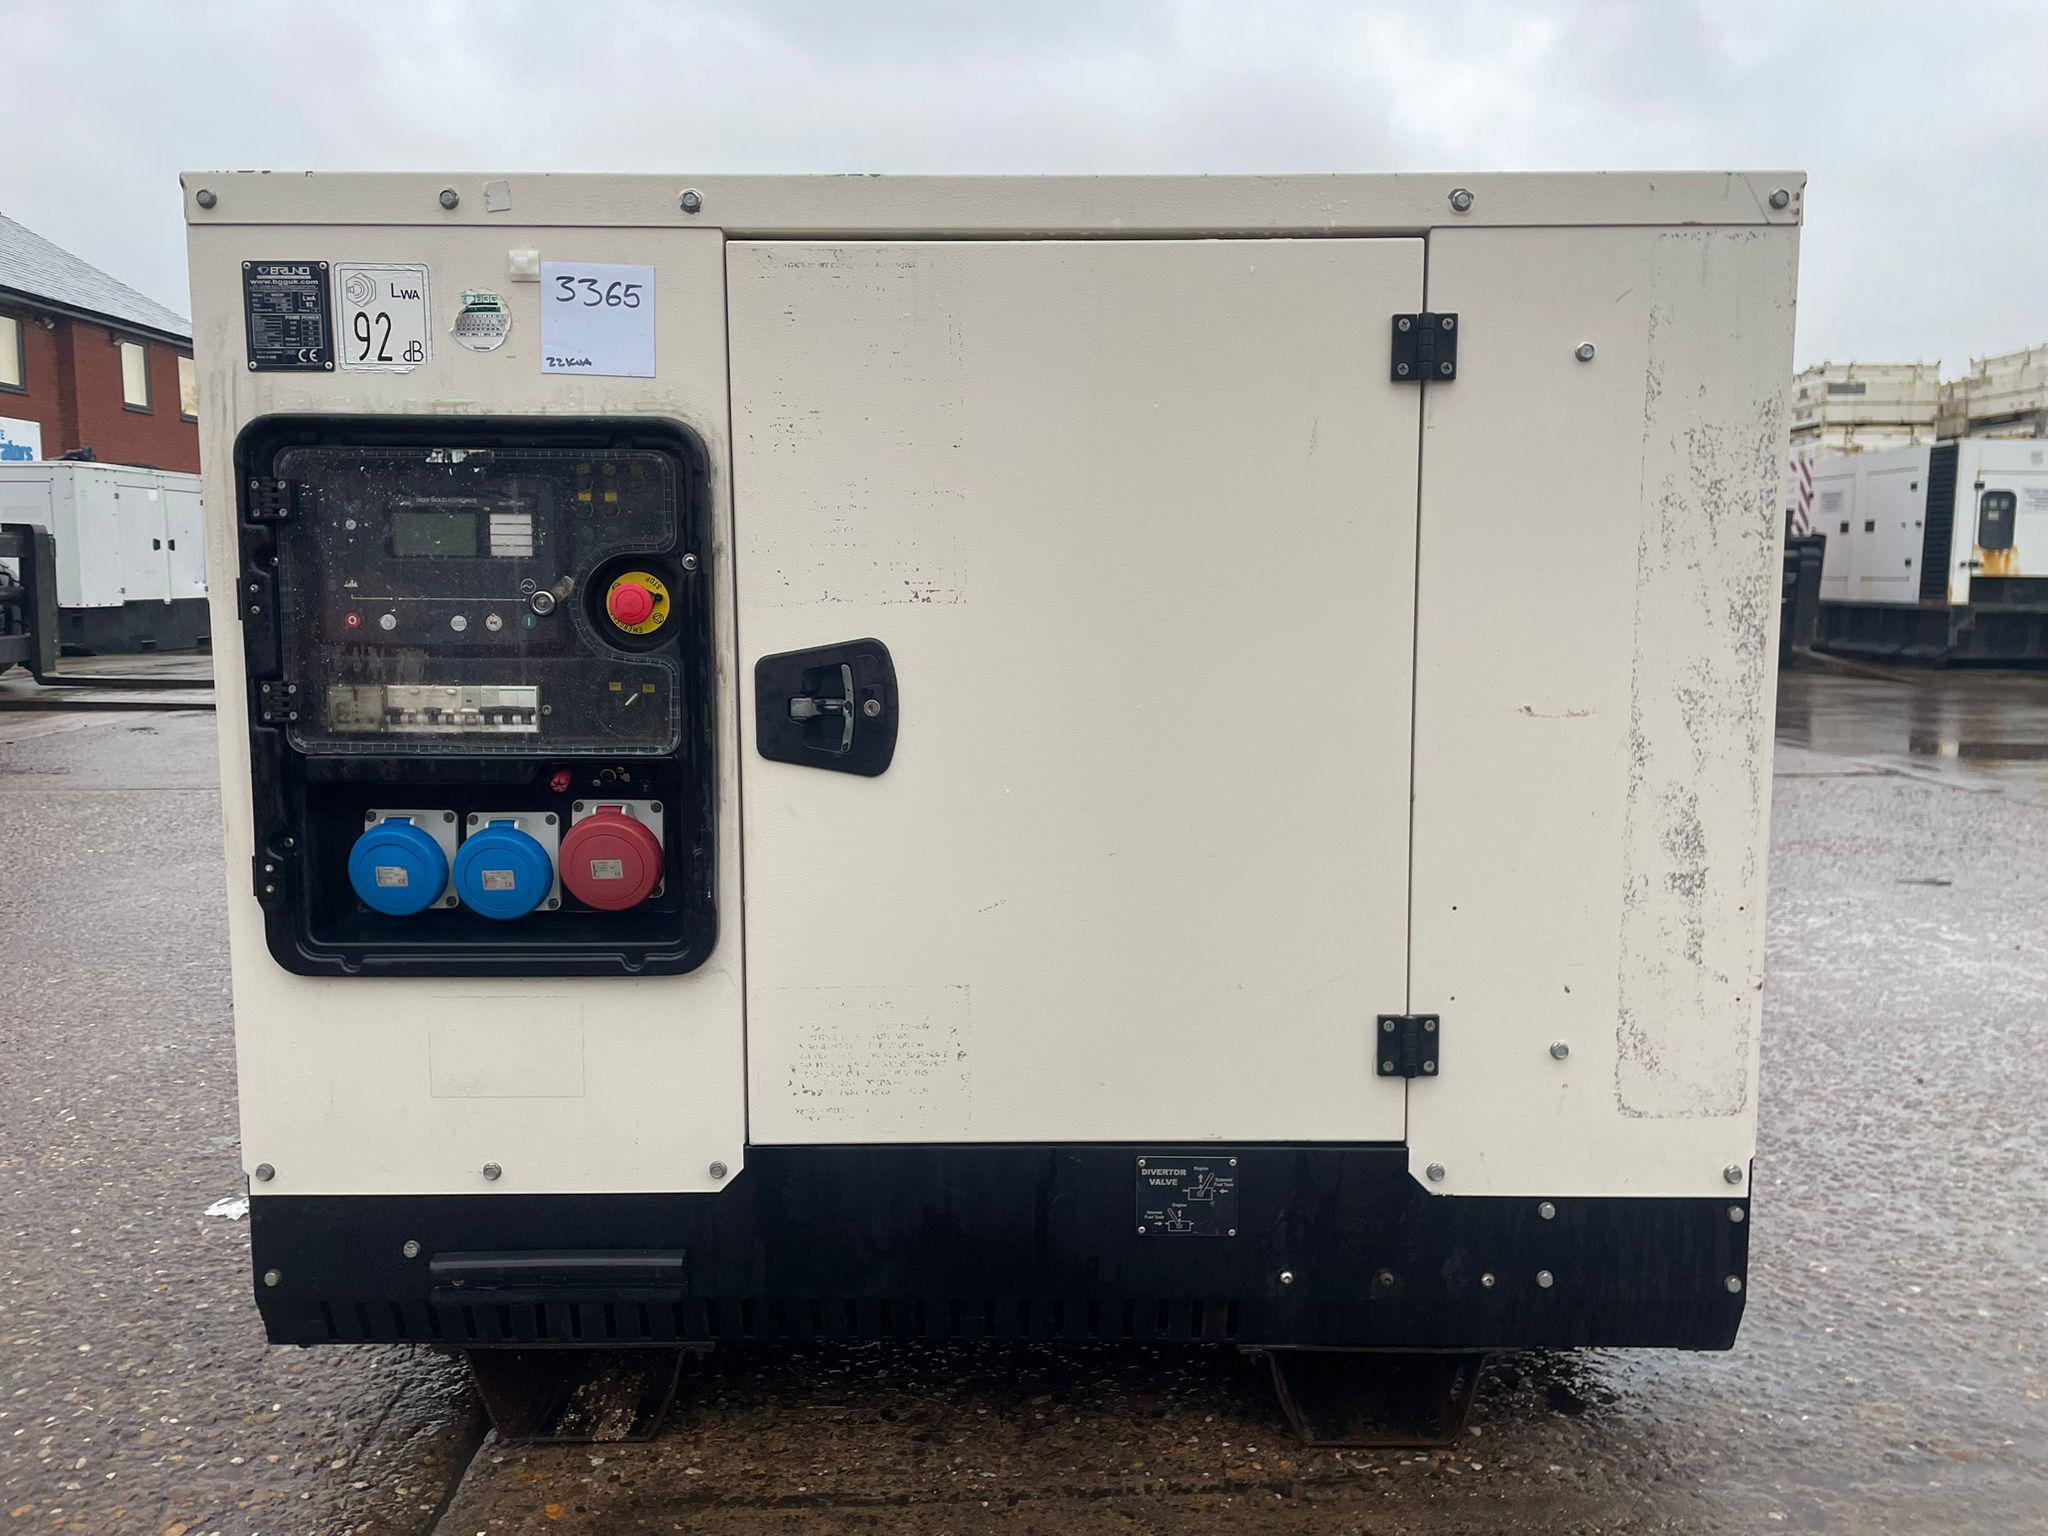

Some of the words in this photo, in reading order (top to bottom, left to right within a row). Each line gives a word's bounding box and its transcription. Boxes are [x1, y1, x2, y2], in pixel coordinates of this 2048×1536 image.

[555, 275, 643, 309] 3365
[353, 311, 393, 362] 92
[402, 340, 424, 363] dB
[645, 576, 662, 590] STOP
[1141, 1168, 1187, 1176] DIVERTOR
[1149, 1178, 1178, 1186] VALVE
